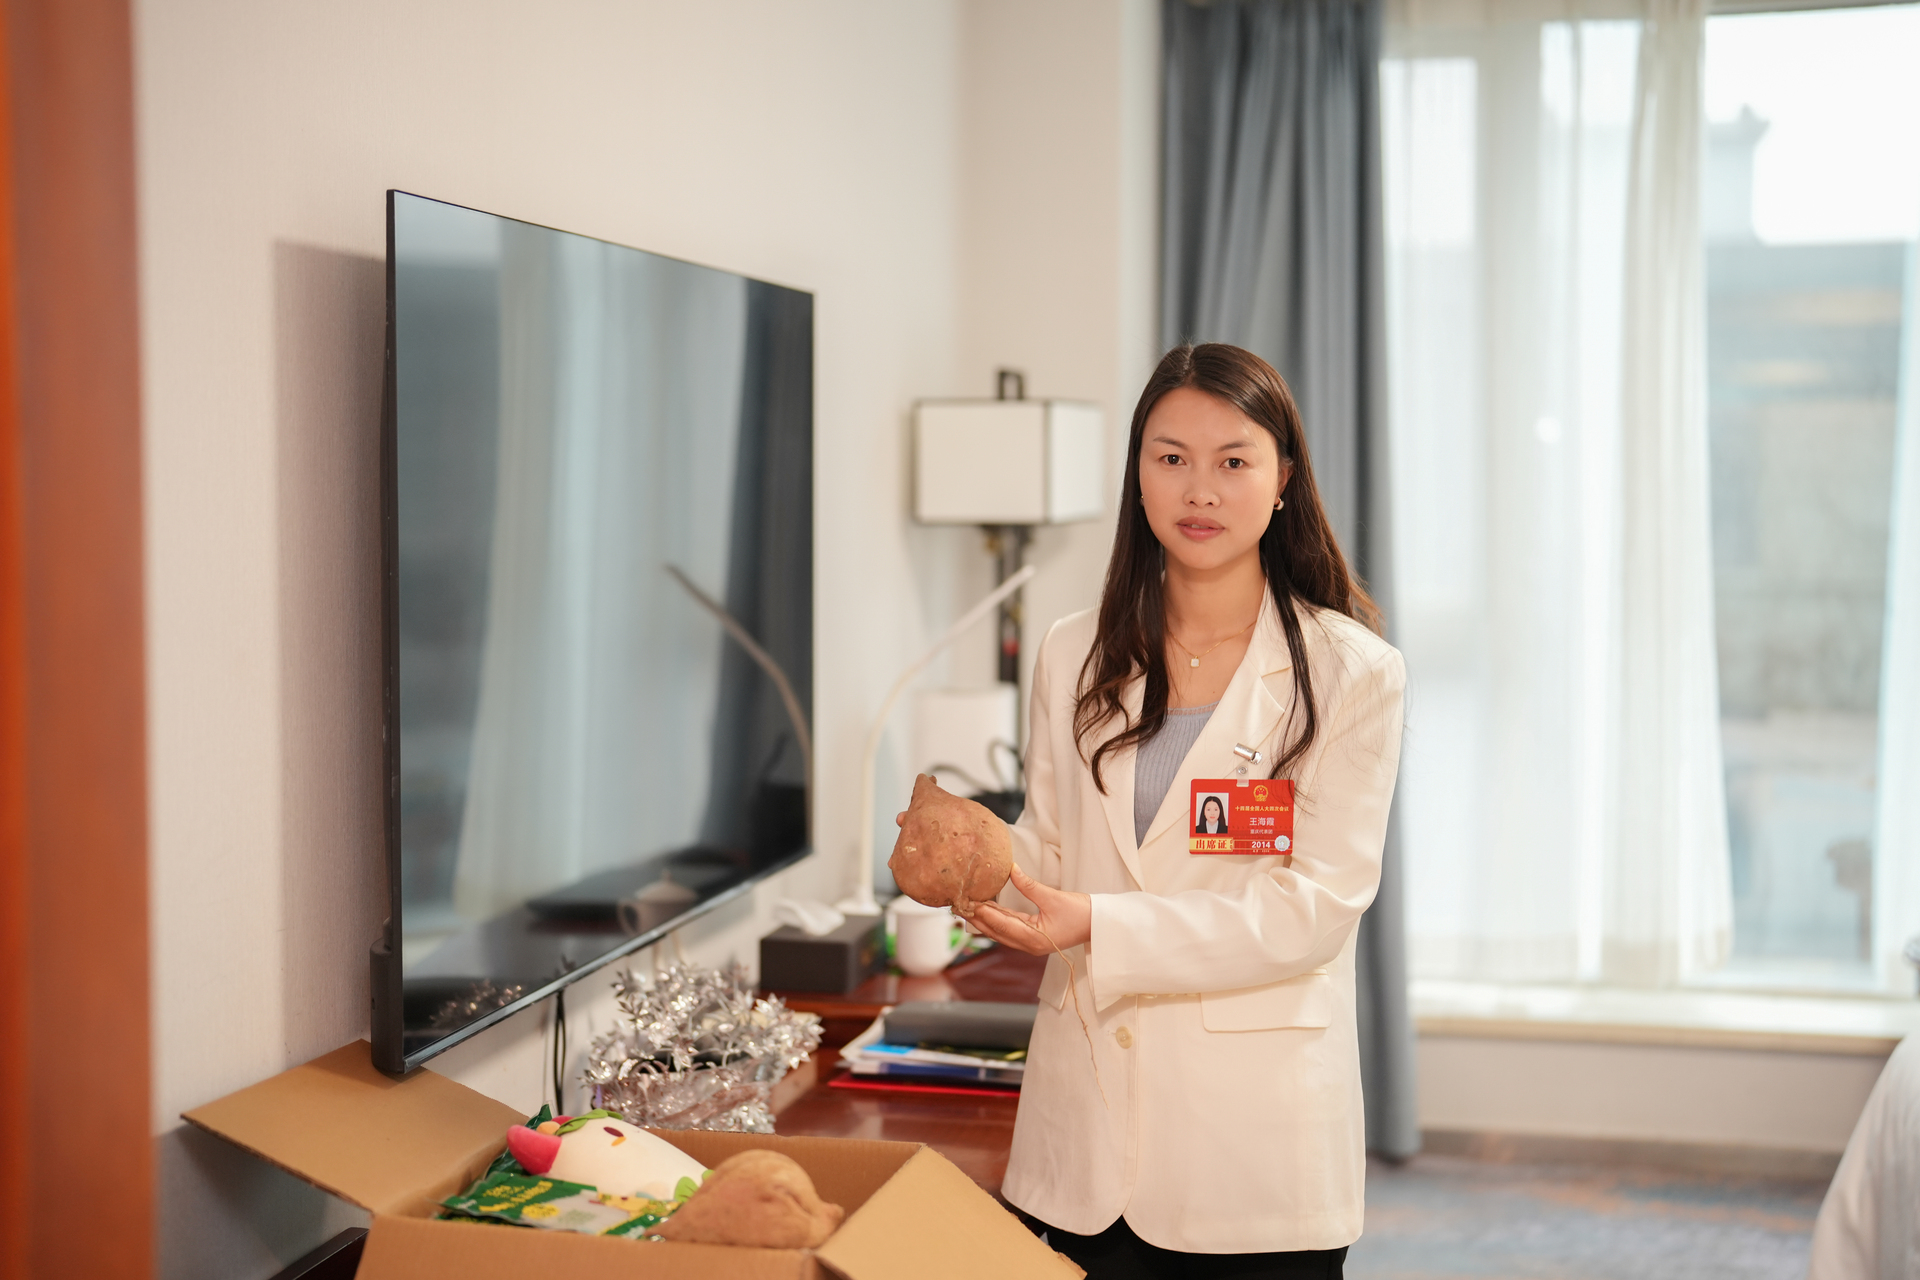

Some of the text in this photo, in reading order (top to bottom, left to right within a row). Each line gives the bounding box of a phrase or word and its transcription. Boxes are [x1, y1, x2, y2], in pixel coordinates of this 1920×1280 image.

[1249, 817, 1274, 826] 王海霞
[1196, 839, 1227, 850] 出席证
